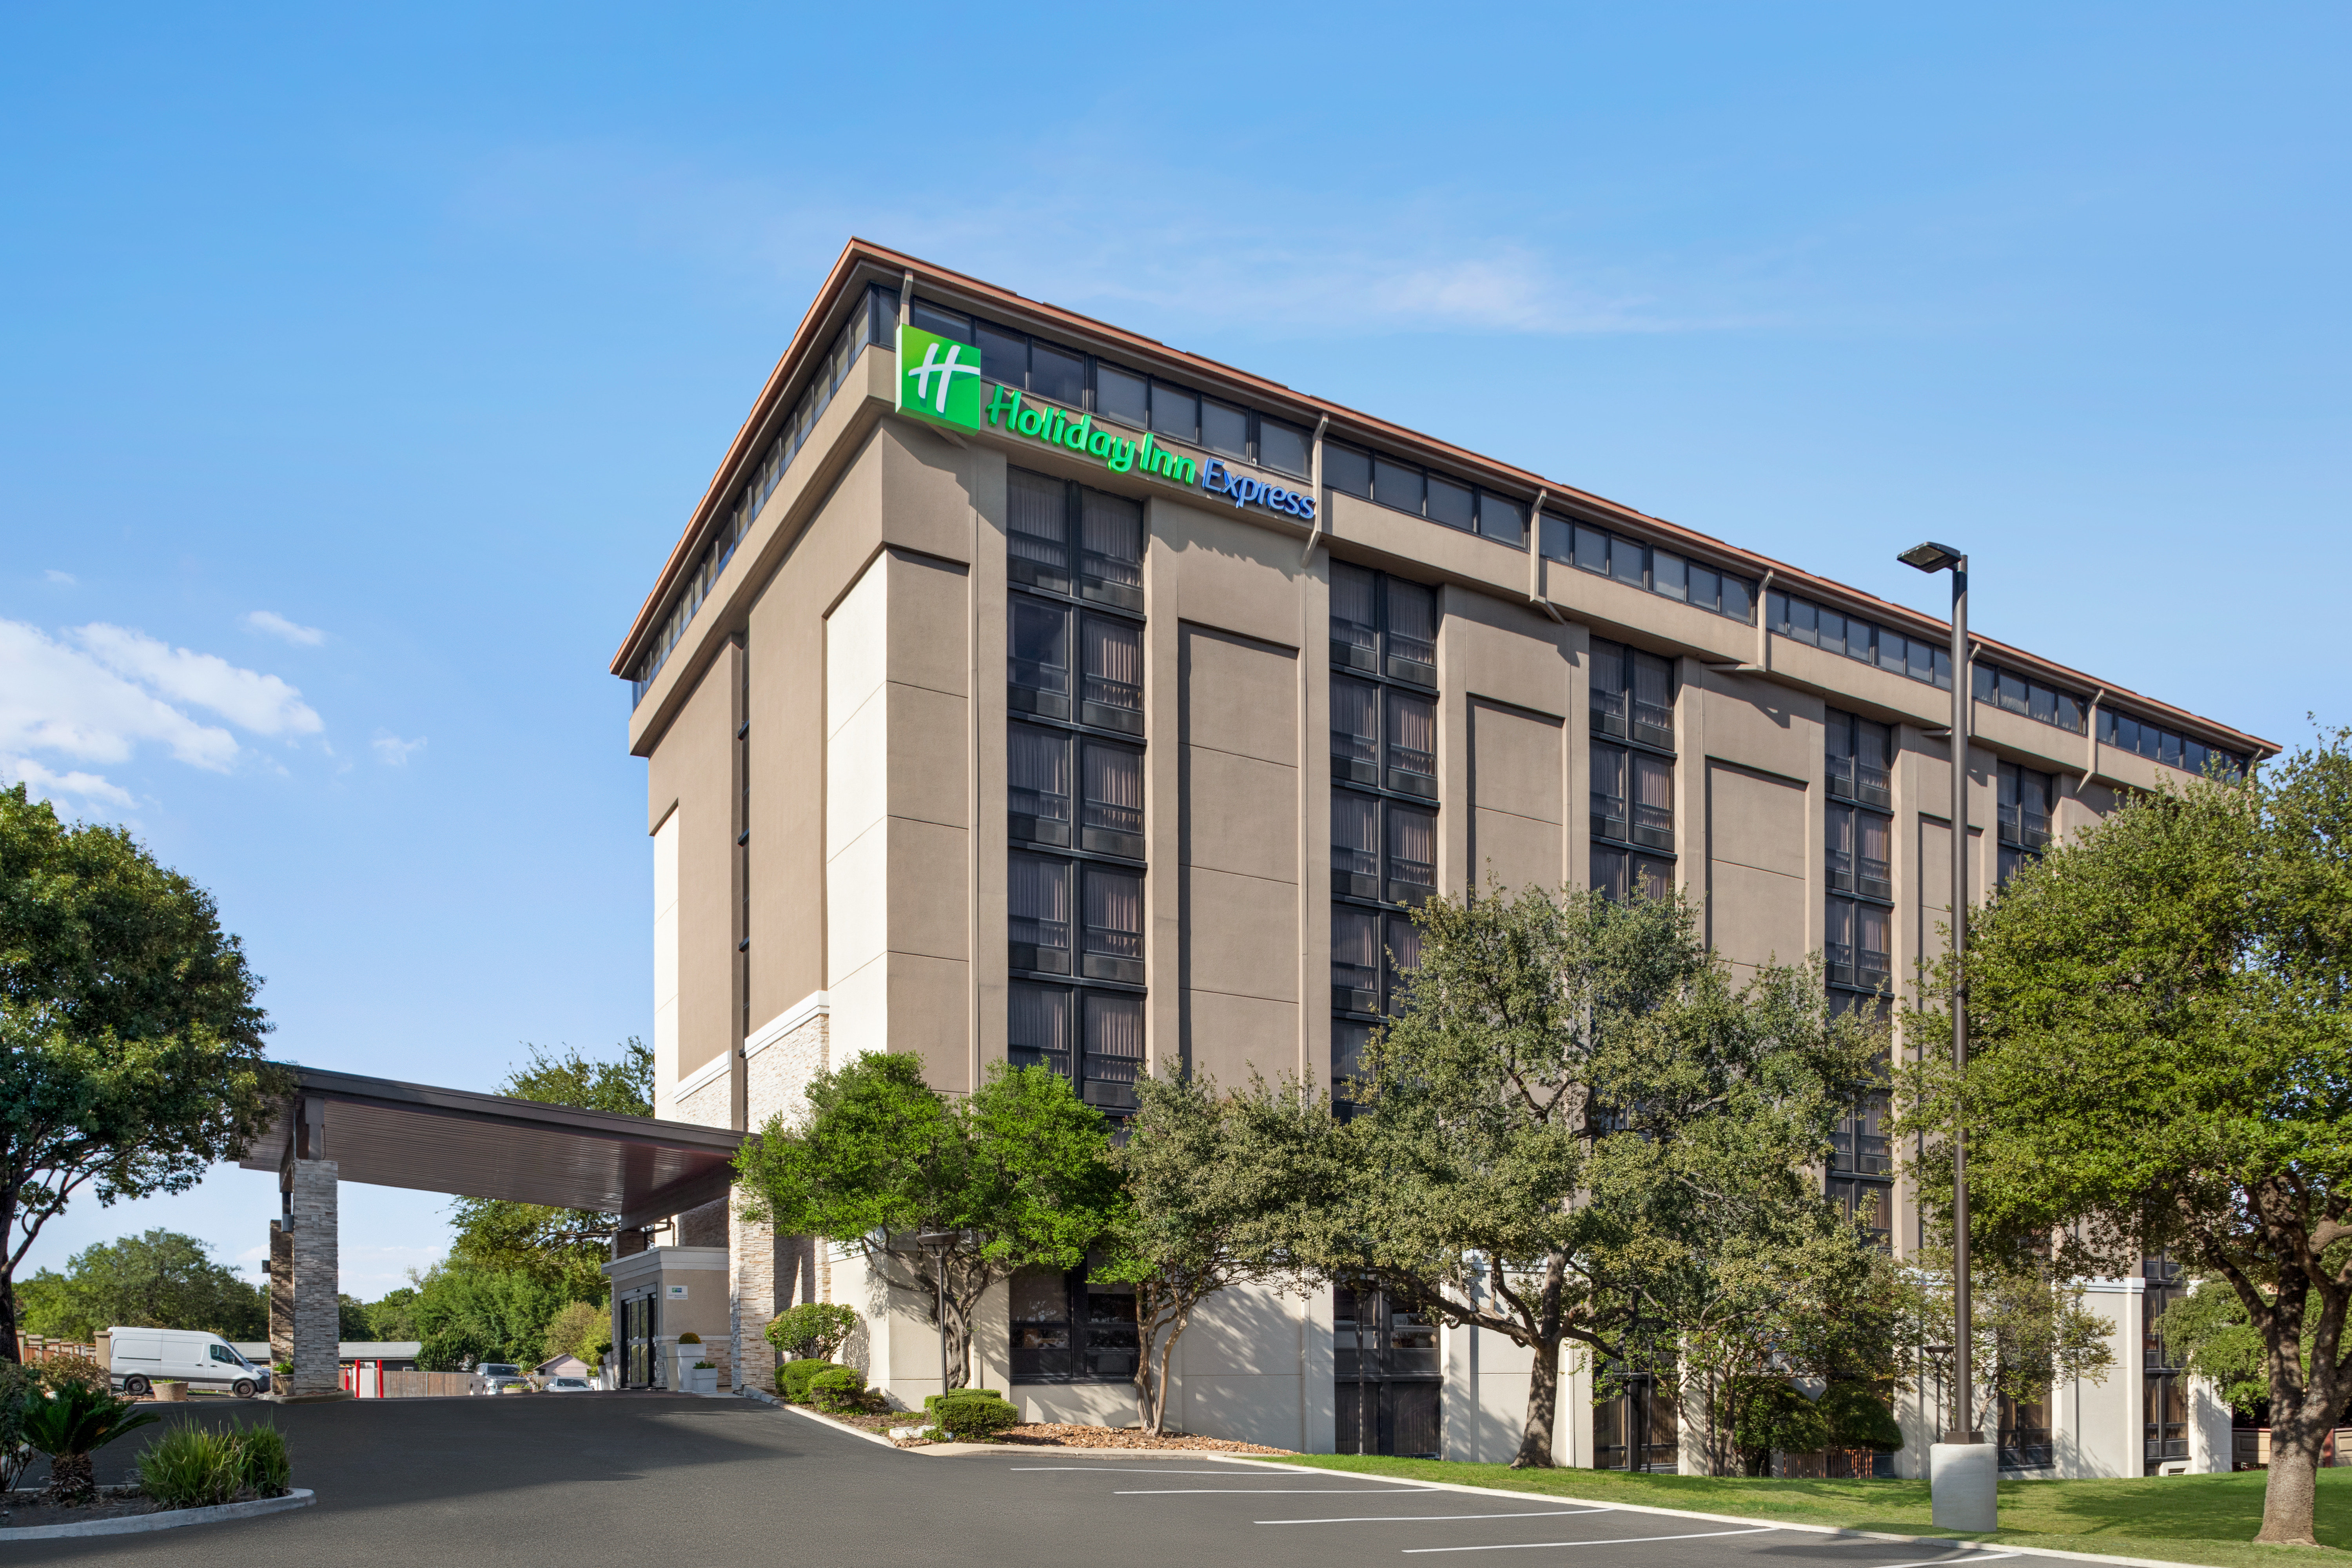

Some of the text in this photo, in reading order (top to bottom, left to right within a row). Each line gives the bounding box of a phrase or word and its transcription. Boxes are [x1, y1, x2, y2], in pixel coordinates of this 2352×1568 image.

[985, 385, 1316, 519] Holiday Inn Express
